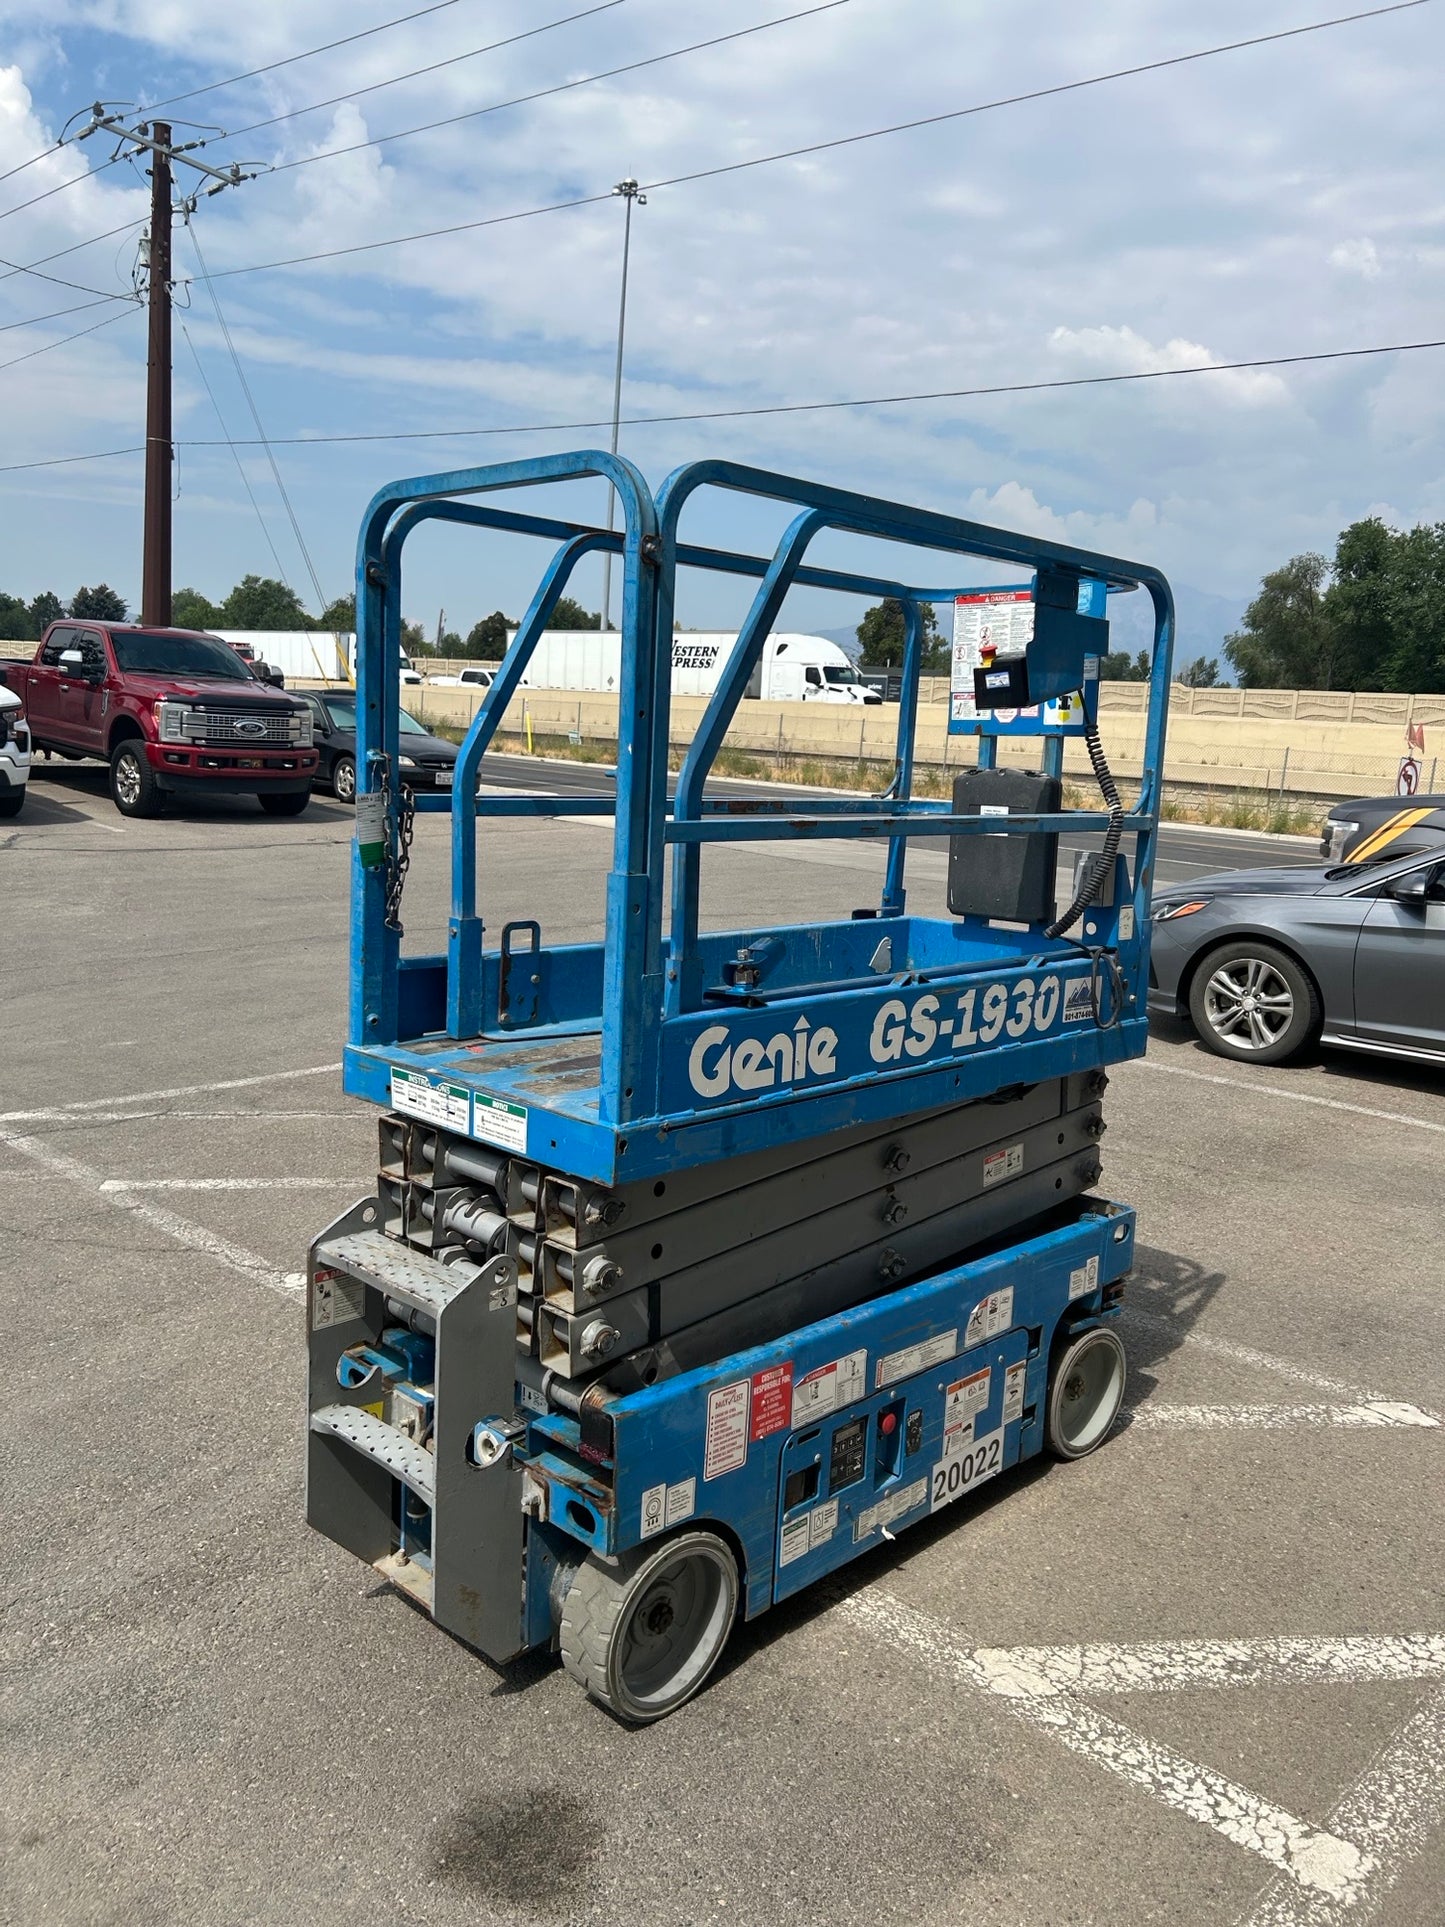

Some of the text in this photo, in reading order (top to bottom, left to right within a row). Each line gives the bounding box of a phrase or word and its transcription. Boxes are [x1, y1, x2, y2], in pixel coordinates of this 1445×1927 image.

[990, 594, 1016, 602] DANGER
[688, 975, 1060, 1098] Genie GS-1930
[933, 1438, 1000, 1503] 20022
